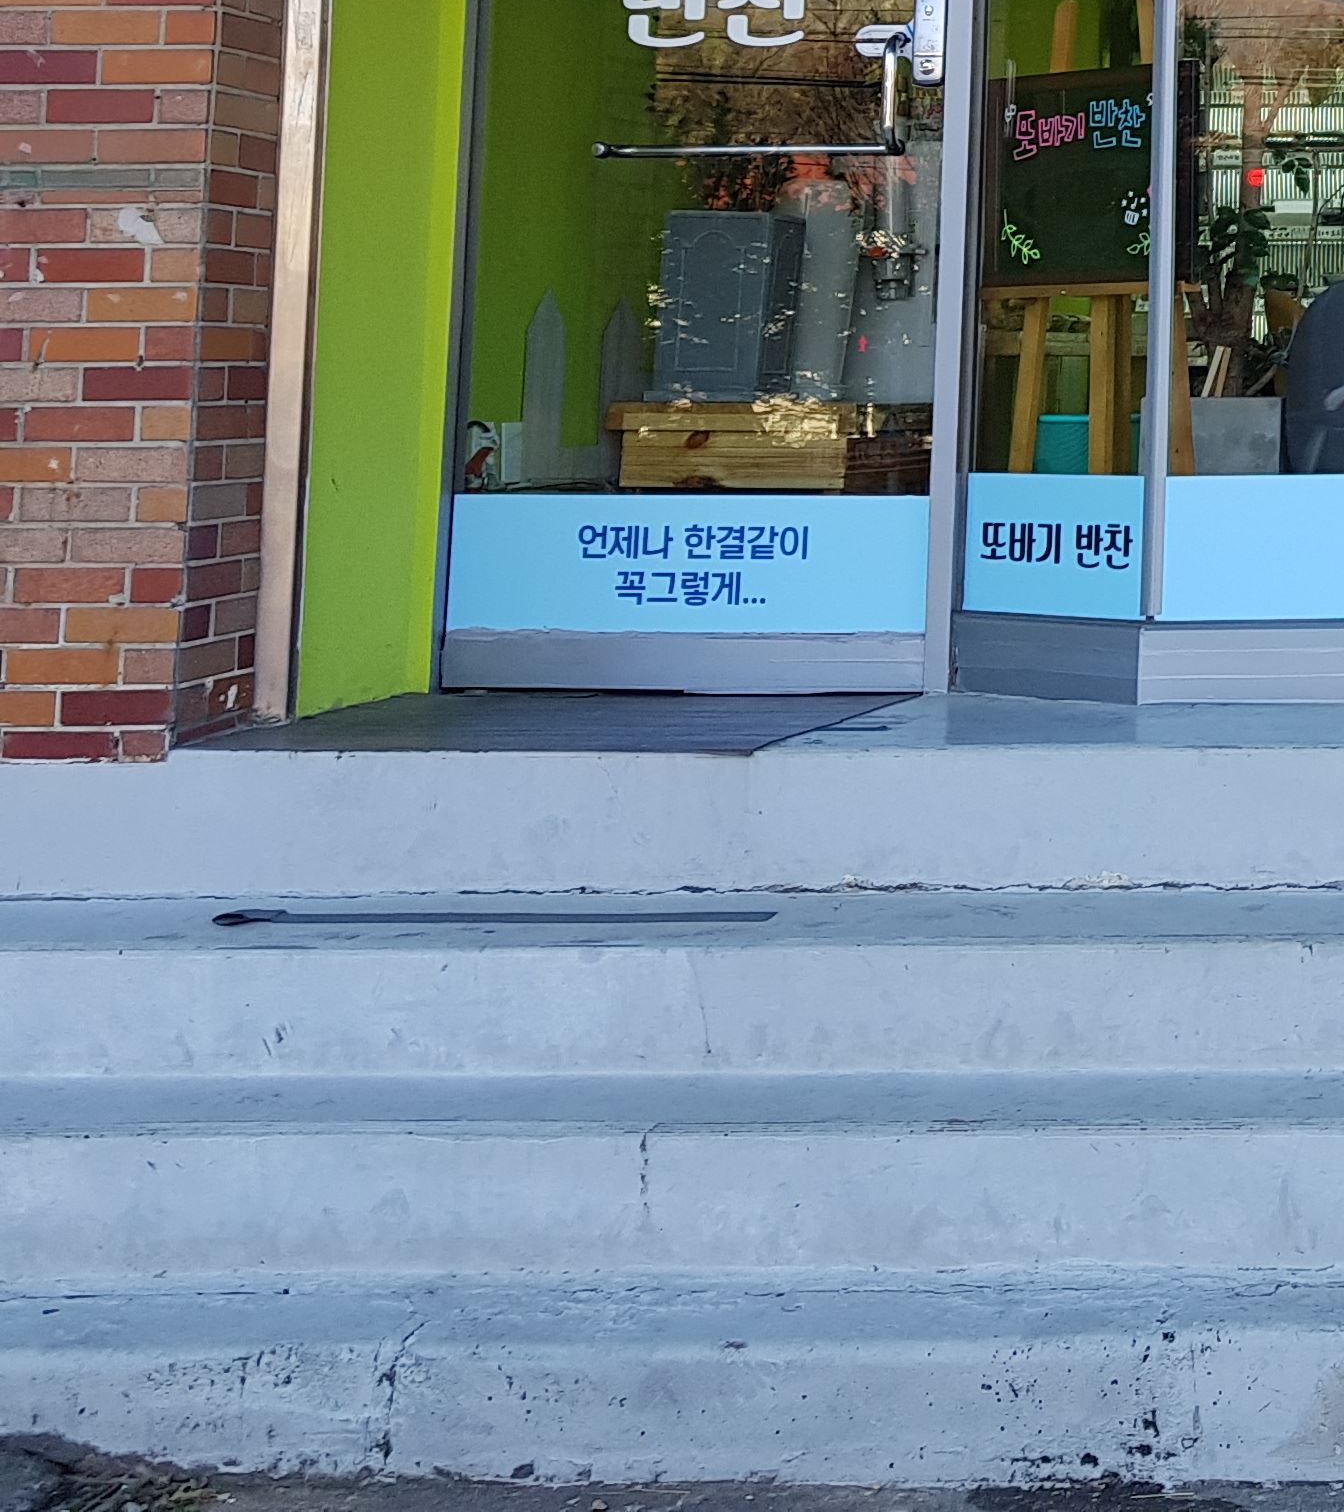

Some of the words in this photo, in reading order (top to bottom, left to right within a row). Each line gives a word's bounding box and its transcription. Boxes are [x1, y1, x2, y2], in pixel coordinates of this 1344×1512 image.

[1013, 109, 1085, 161] 또바기
[1089, 98, 1146, 149] 반찬
[577, 524, 674, 560] 언제나
[683, 523, 809, 561] 한결같이
[980, 521, 1062, 565] 또바기
[1074, 523, 1134, 570] 반찬
[614, 571, 767, 607] 꼭그렇게...
